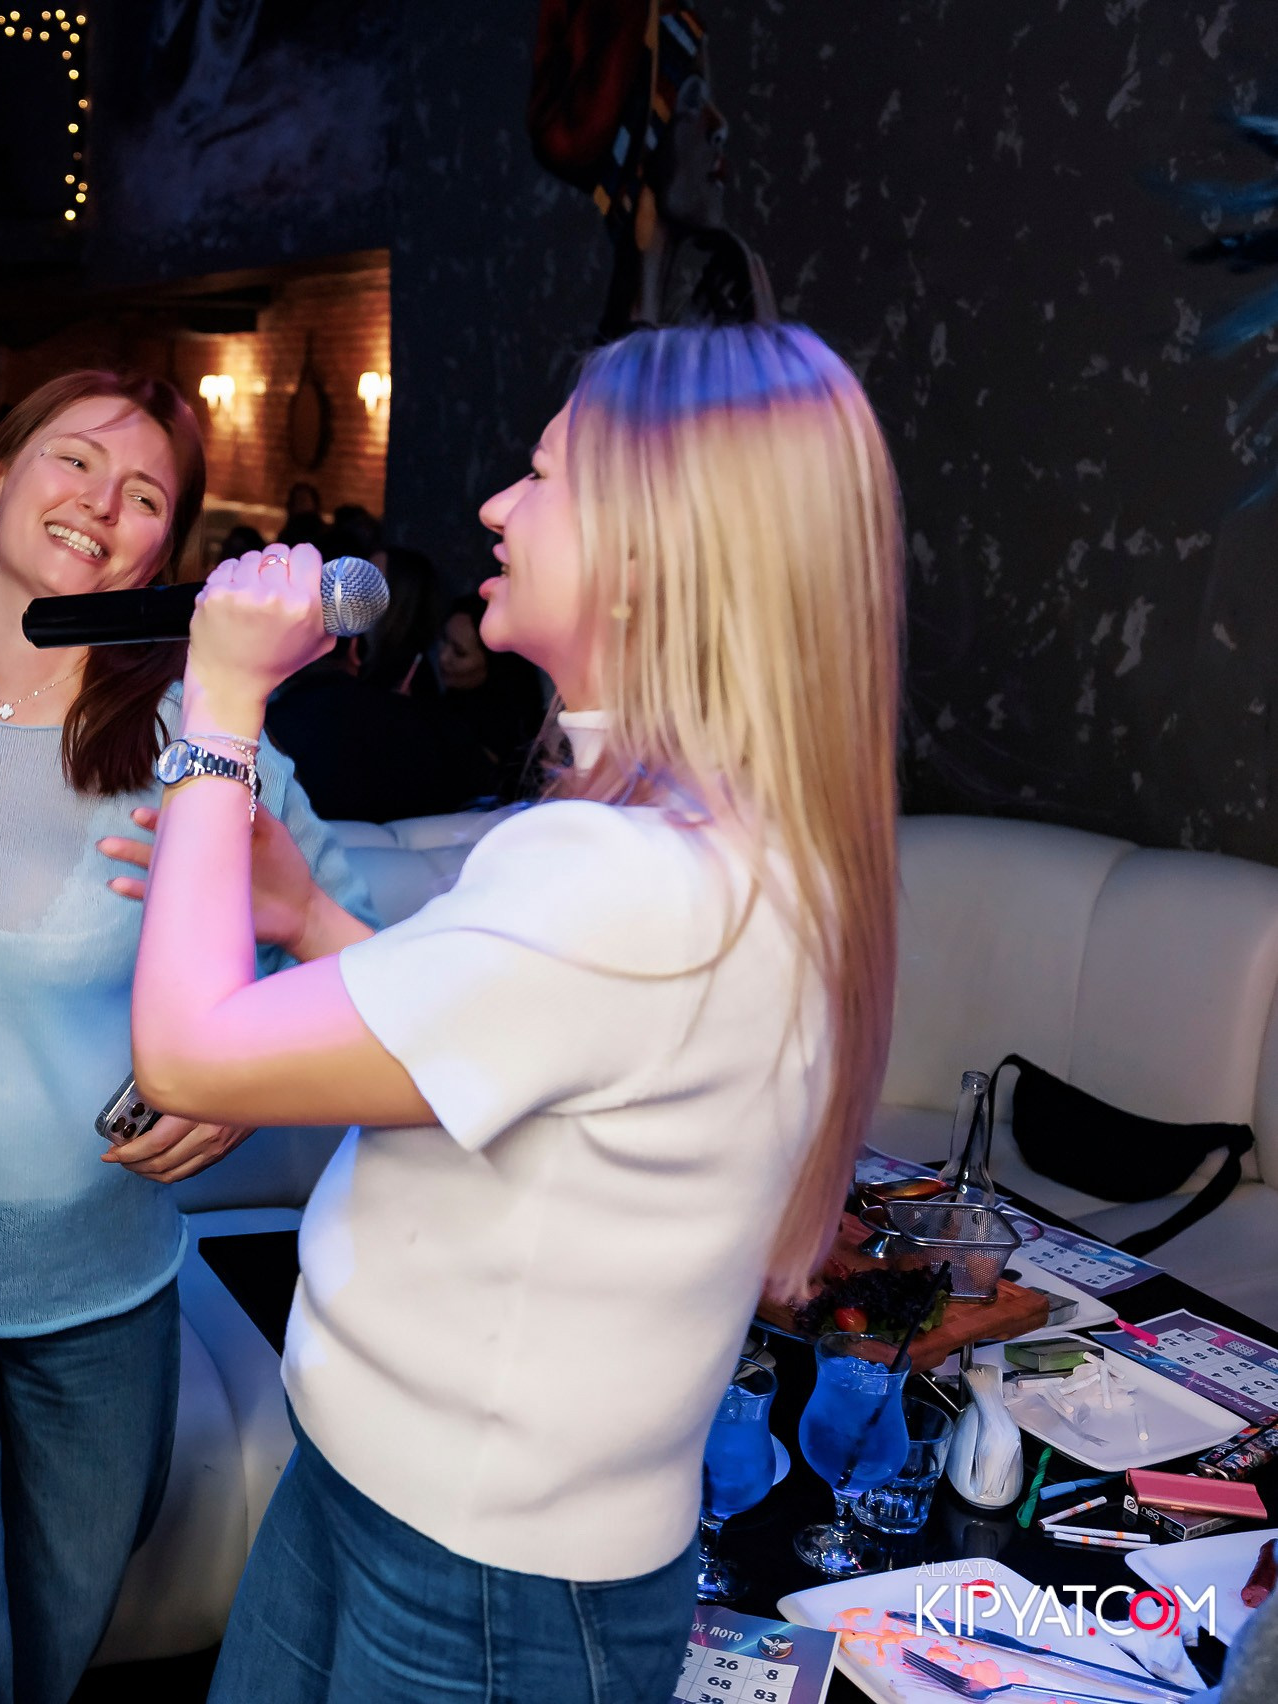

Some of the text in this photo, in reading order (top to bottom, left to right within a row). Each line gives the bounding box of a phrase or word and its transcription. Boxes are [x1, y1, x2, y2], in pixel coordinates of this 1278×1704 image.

[1141, 1506, 1160, 1520] neo
[709, 1626, 744, 1642] ЛОТО
[714, 1657, 739, 1671] 26
[766, 1669, 779, 1681] 8
[707, 1676, 778, 1703] 68 83
